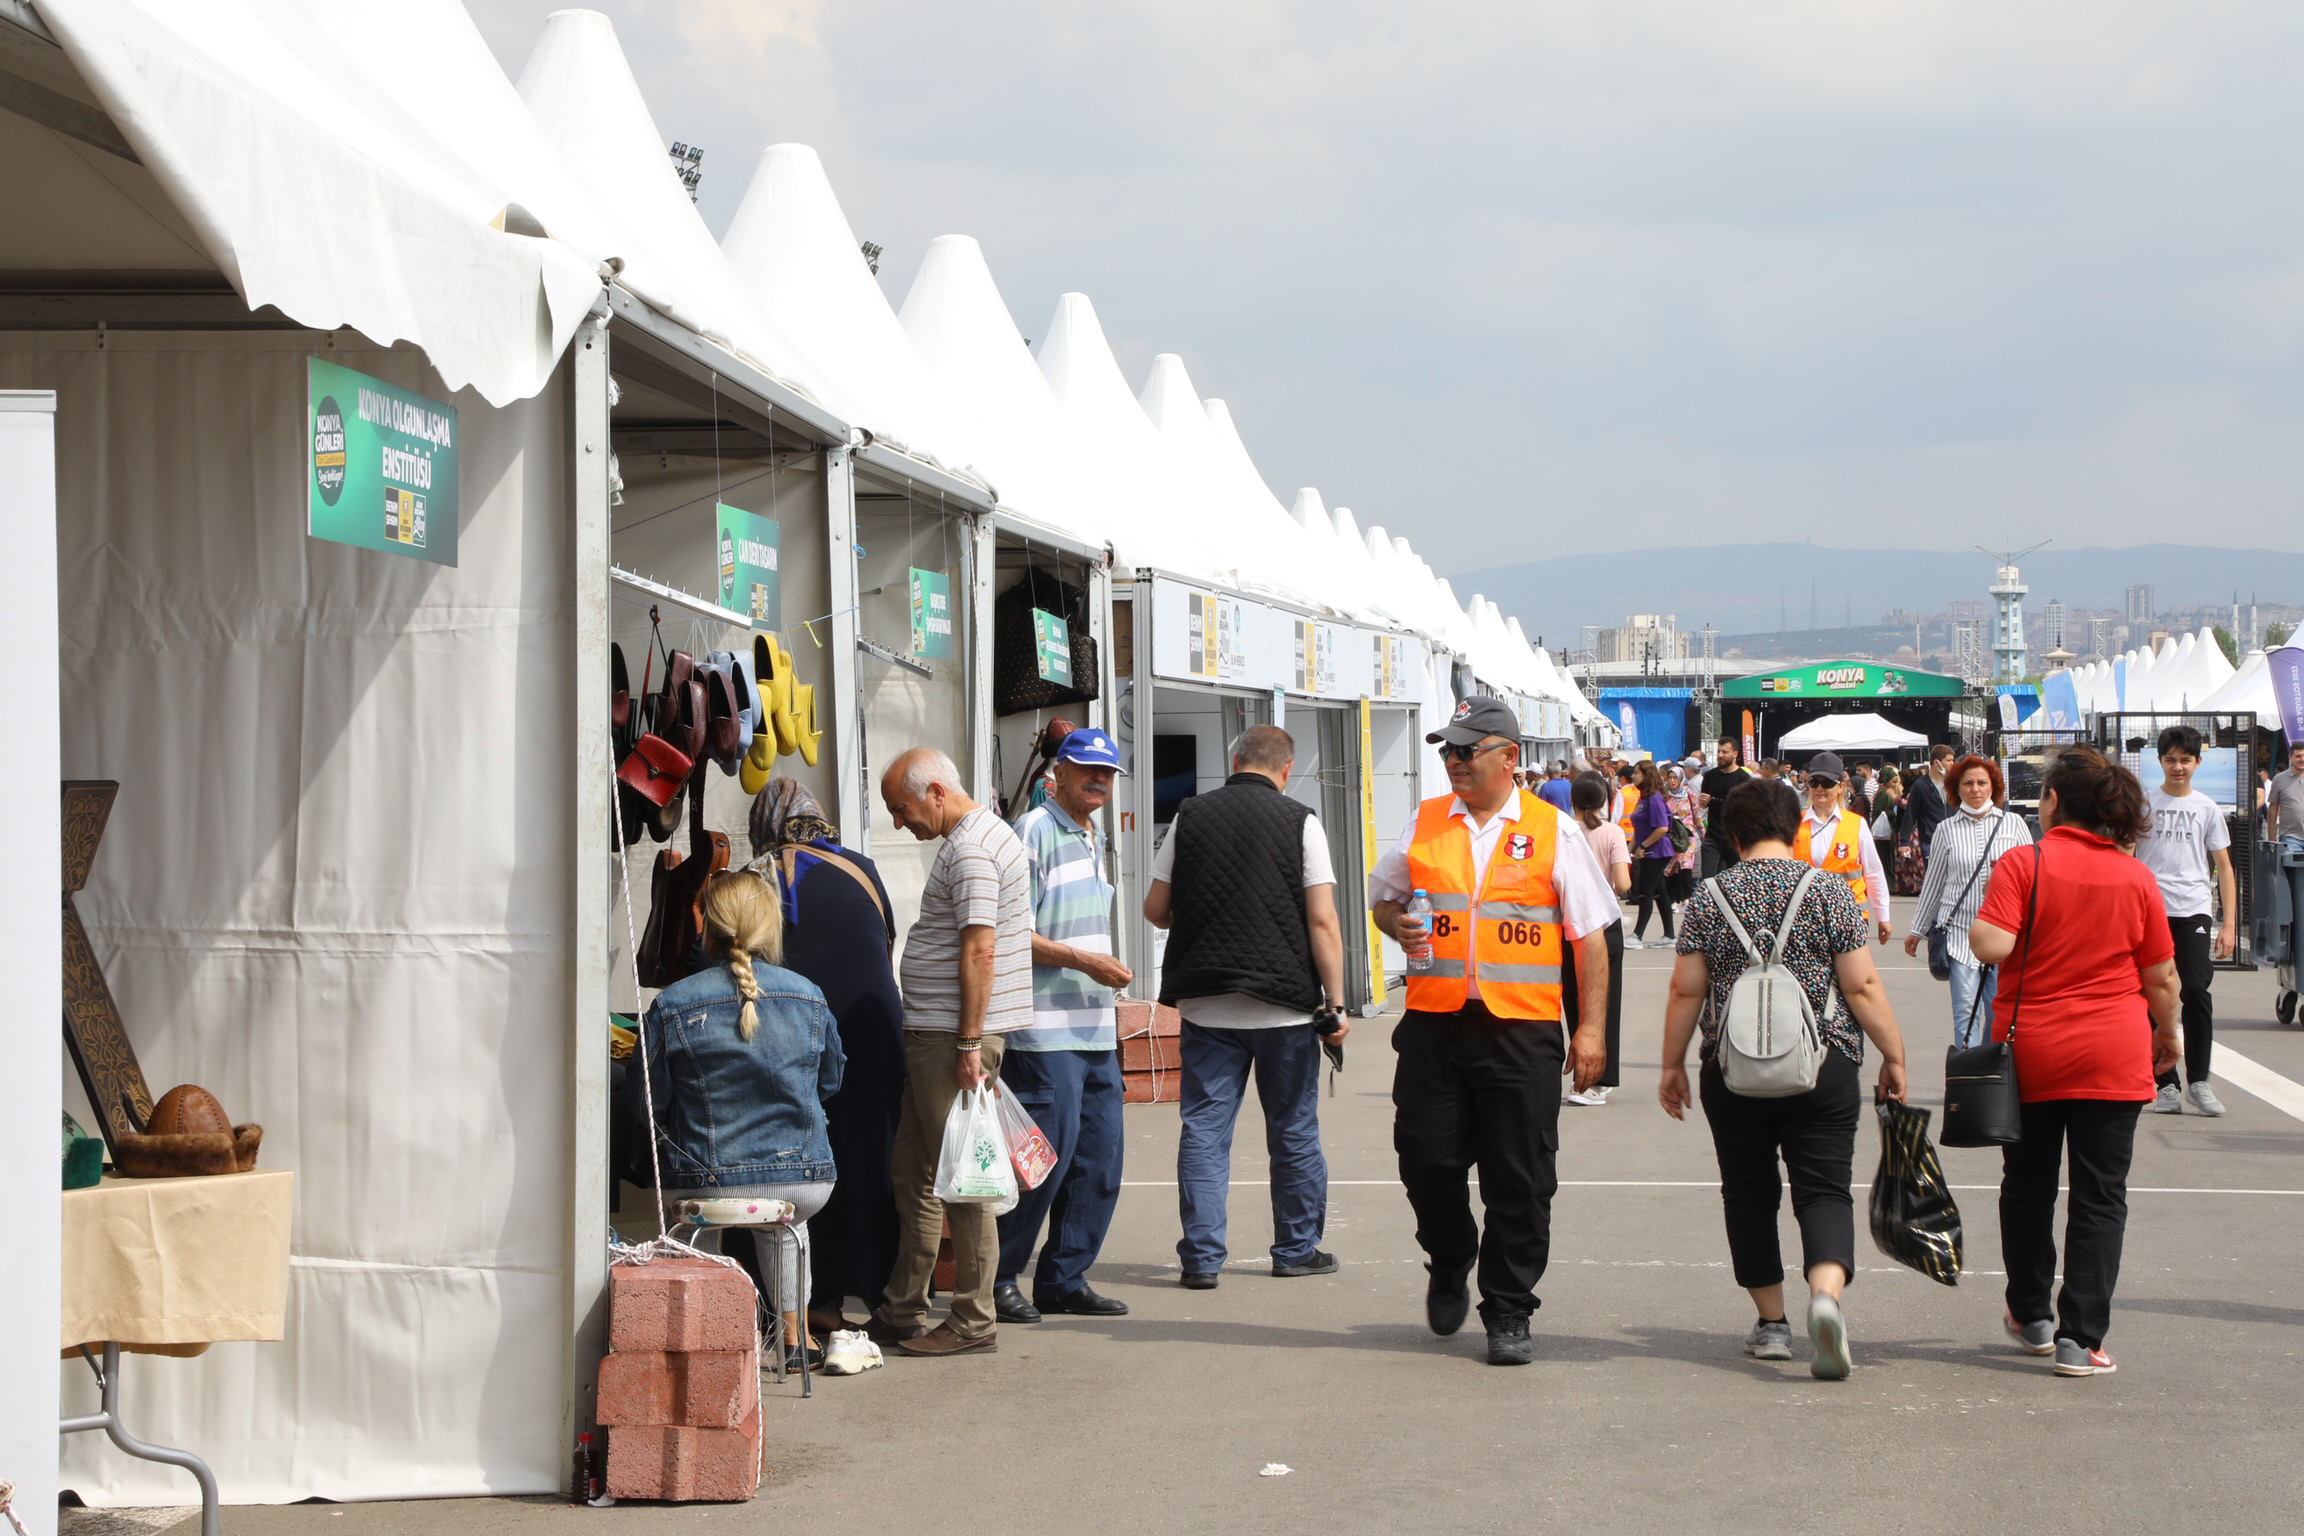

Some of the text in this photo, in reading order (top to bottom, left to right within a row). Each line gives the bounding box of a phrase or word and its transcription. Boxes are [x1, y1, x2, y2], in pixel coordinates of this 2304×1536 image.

[317, 414, 341, 432] KONYA
[358, 387, 451, 452] KONYA OLGUNLAŞMA
[383, 444, 431, 490] ENSTİTÜSÜ
[1816, 668, 1865, 686] KONYA
[2156, 809, 2197, 830] STAY
[2156, 830, 2192, 844] TRUE
[1498, 921, 1542, 947] 066
